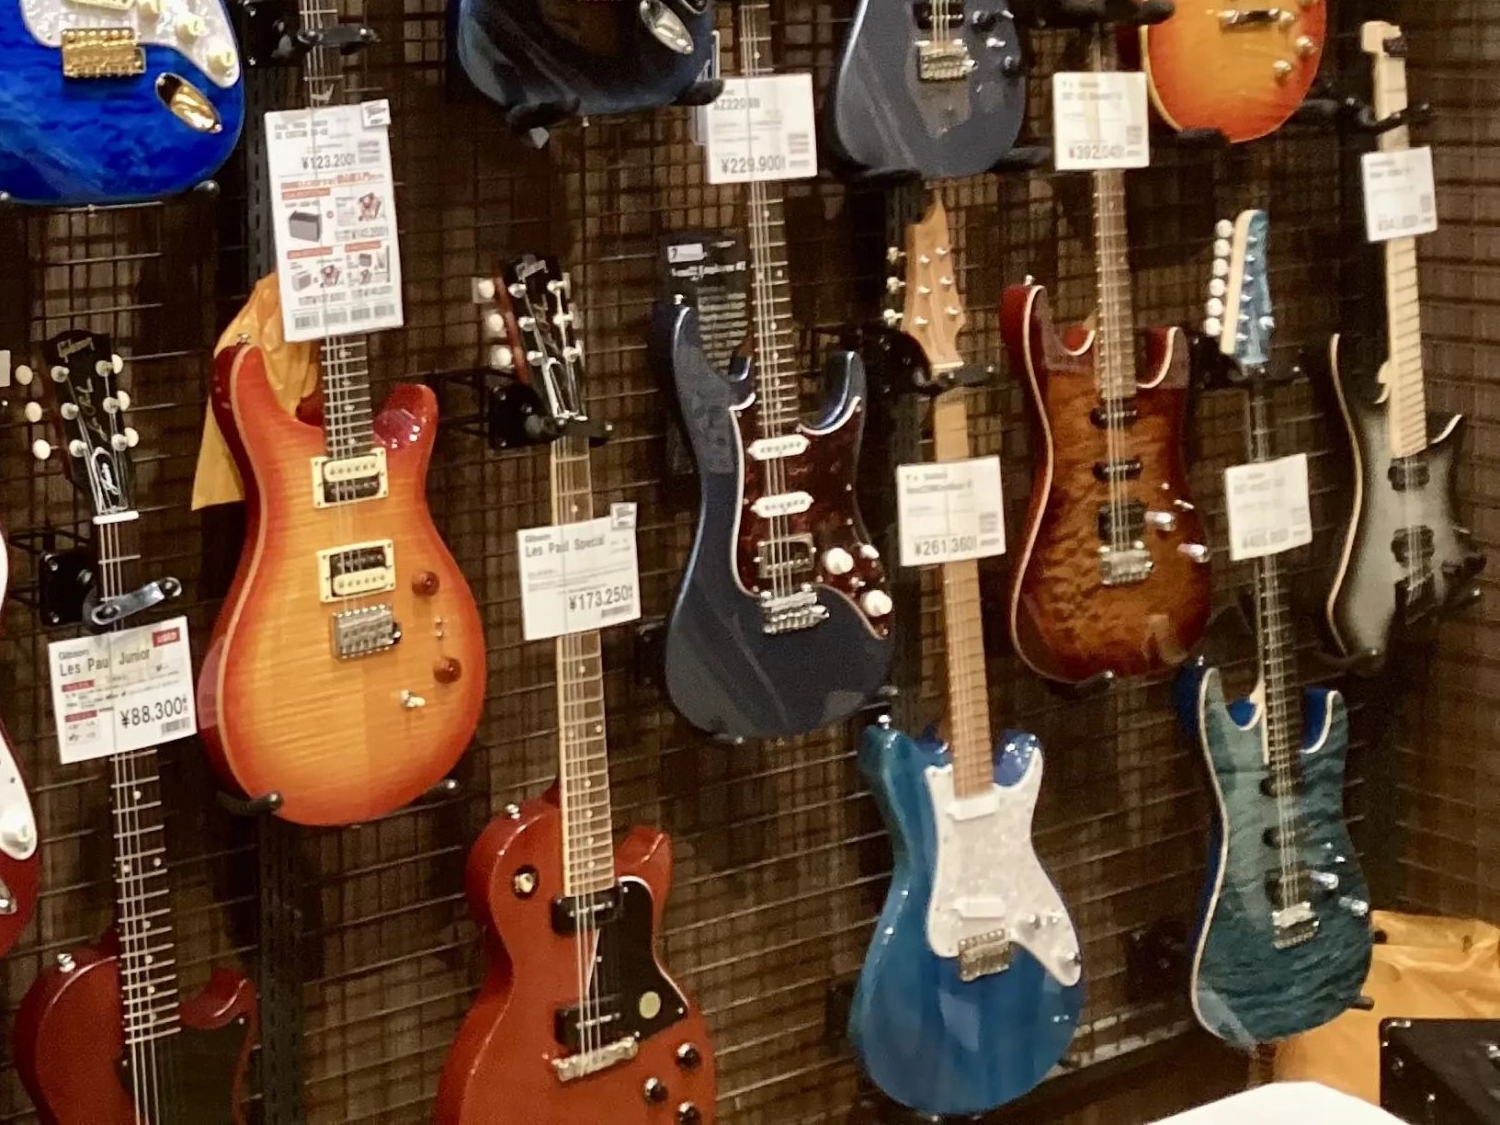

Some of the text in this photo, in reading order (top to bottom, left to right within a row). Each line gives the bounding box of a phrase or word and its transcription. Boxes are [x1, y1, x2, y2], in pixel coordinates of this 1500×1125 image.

[914, 534, 975, 556] ¥261360
[59, 648, 150, 677] Les Pau Junior
